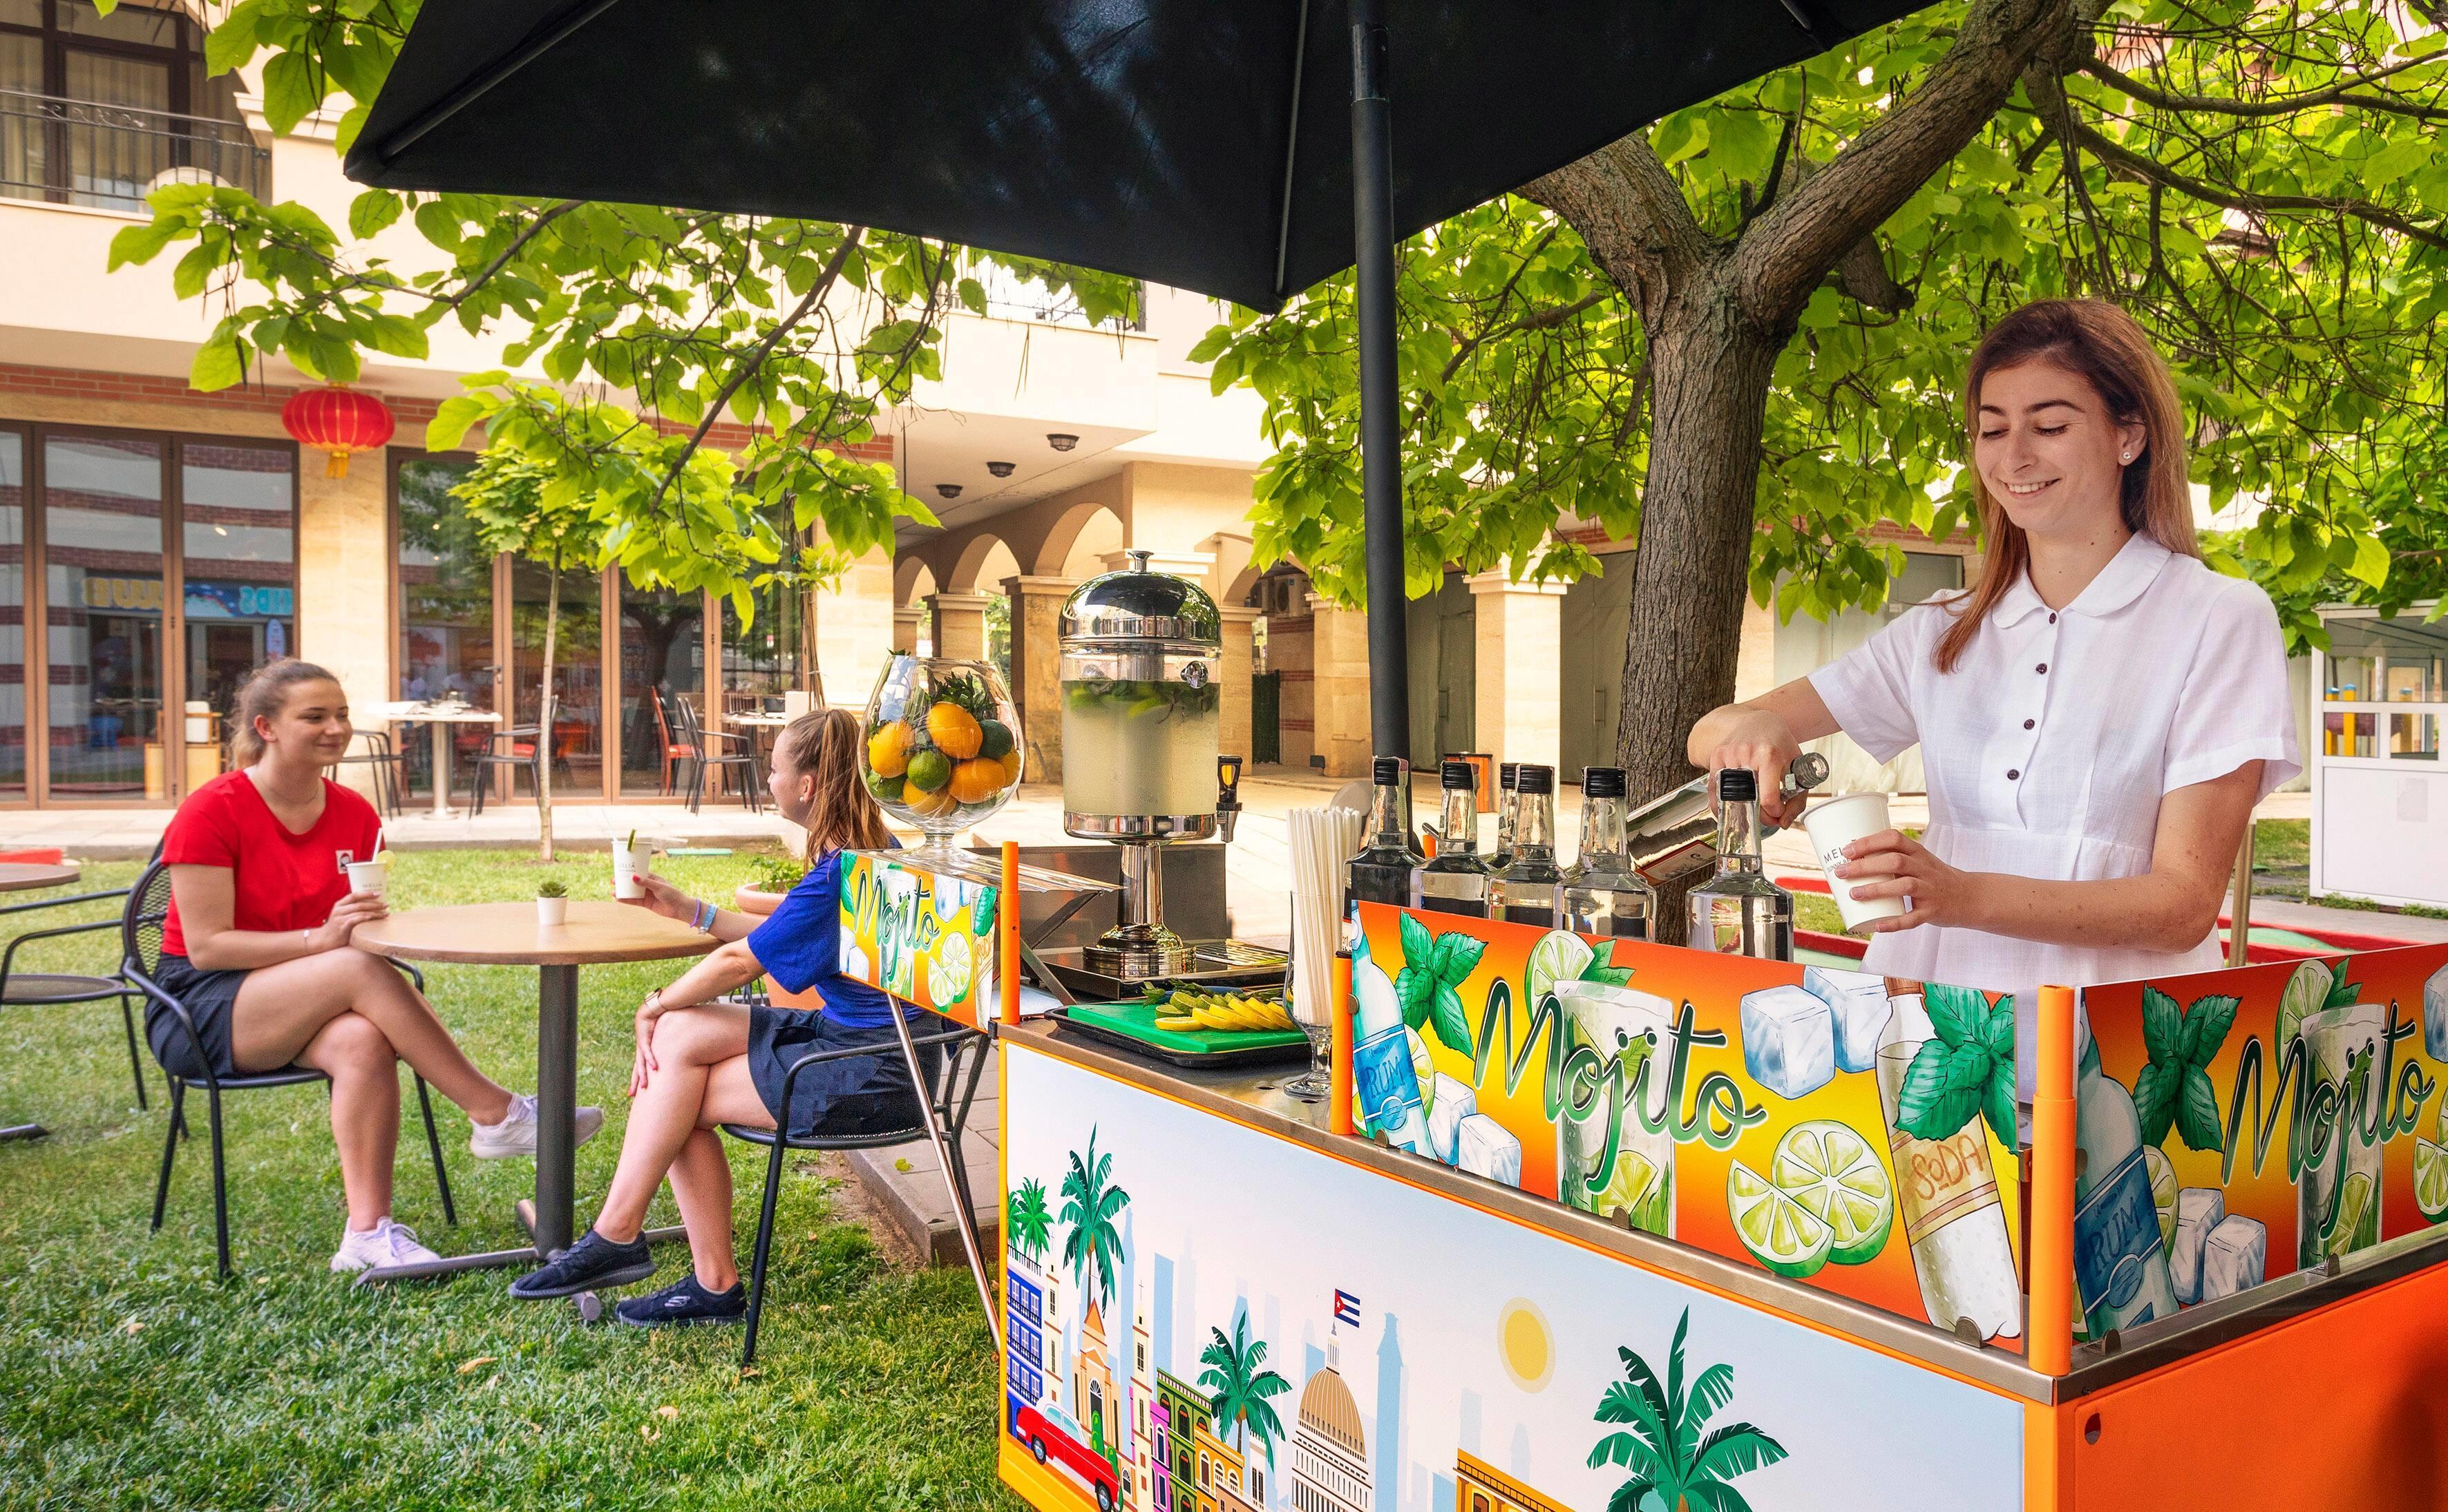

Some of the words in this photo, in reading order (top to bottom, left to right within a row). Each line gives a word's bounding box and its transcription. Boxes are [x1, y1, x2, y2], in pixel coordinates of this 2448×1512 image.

[854, 870, 940, 982] Mojito
[1365, 1056, 1405, 1099] RUM
[1474, 977, 1767, 1194] Mojito
[2222, 1000, 2436, 1241] Mojito
[2087, 1196, 2142, 1277] RUM
